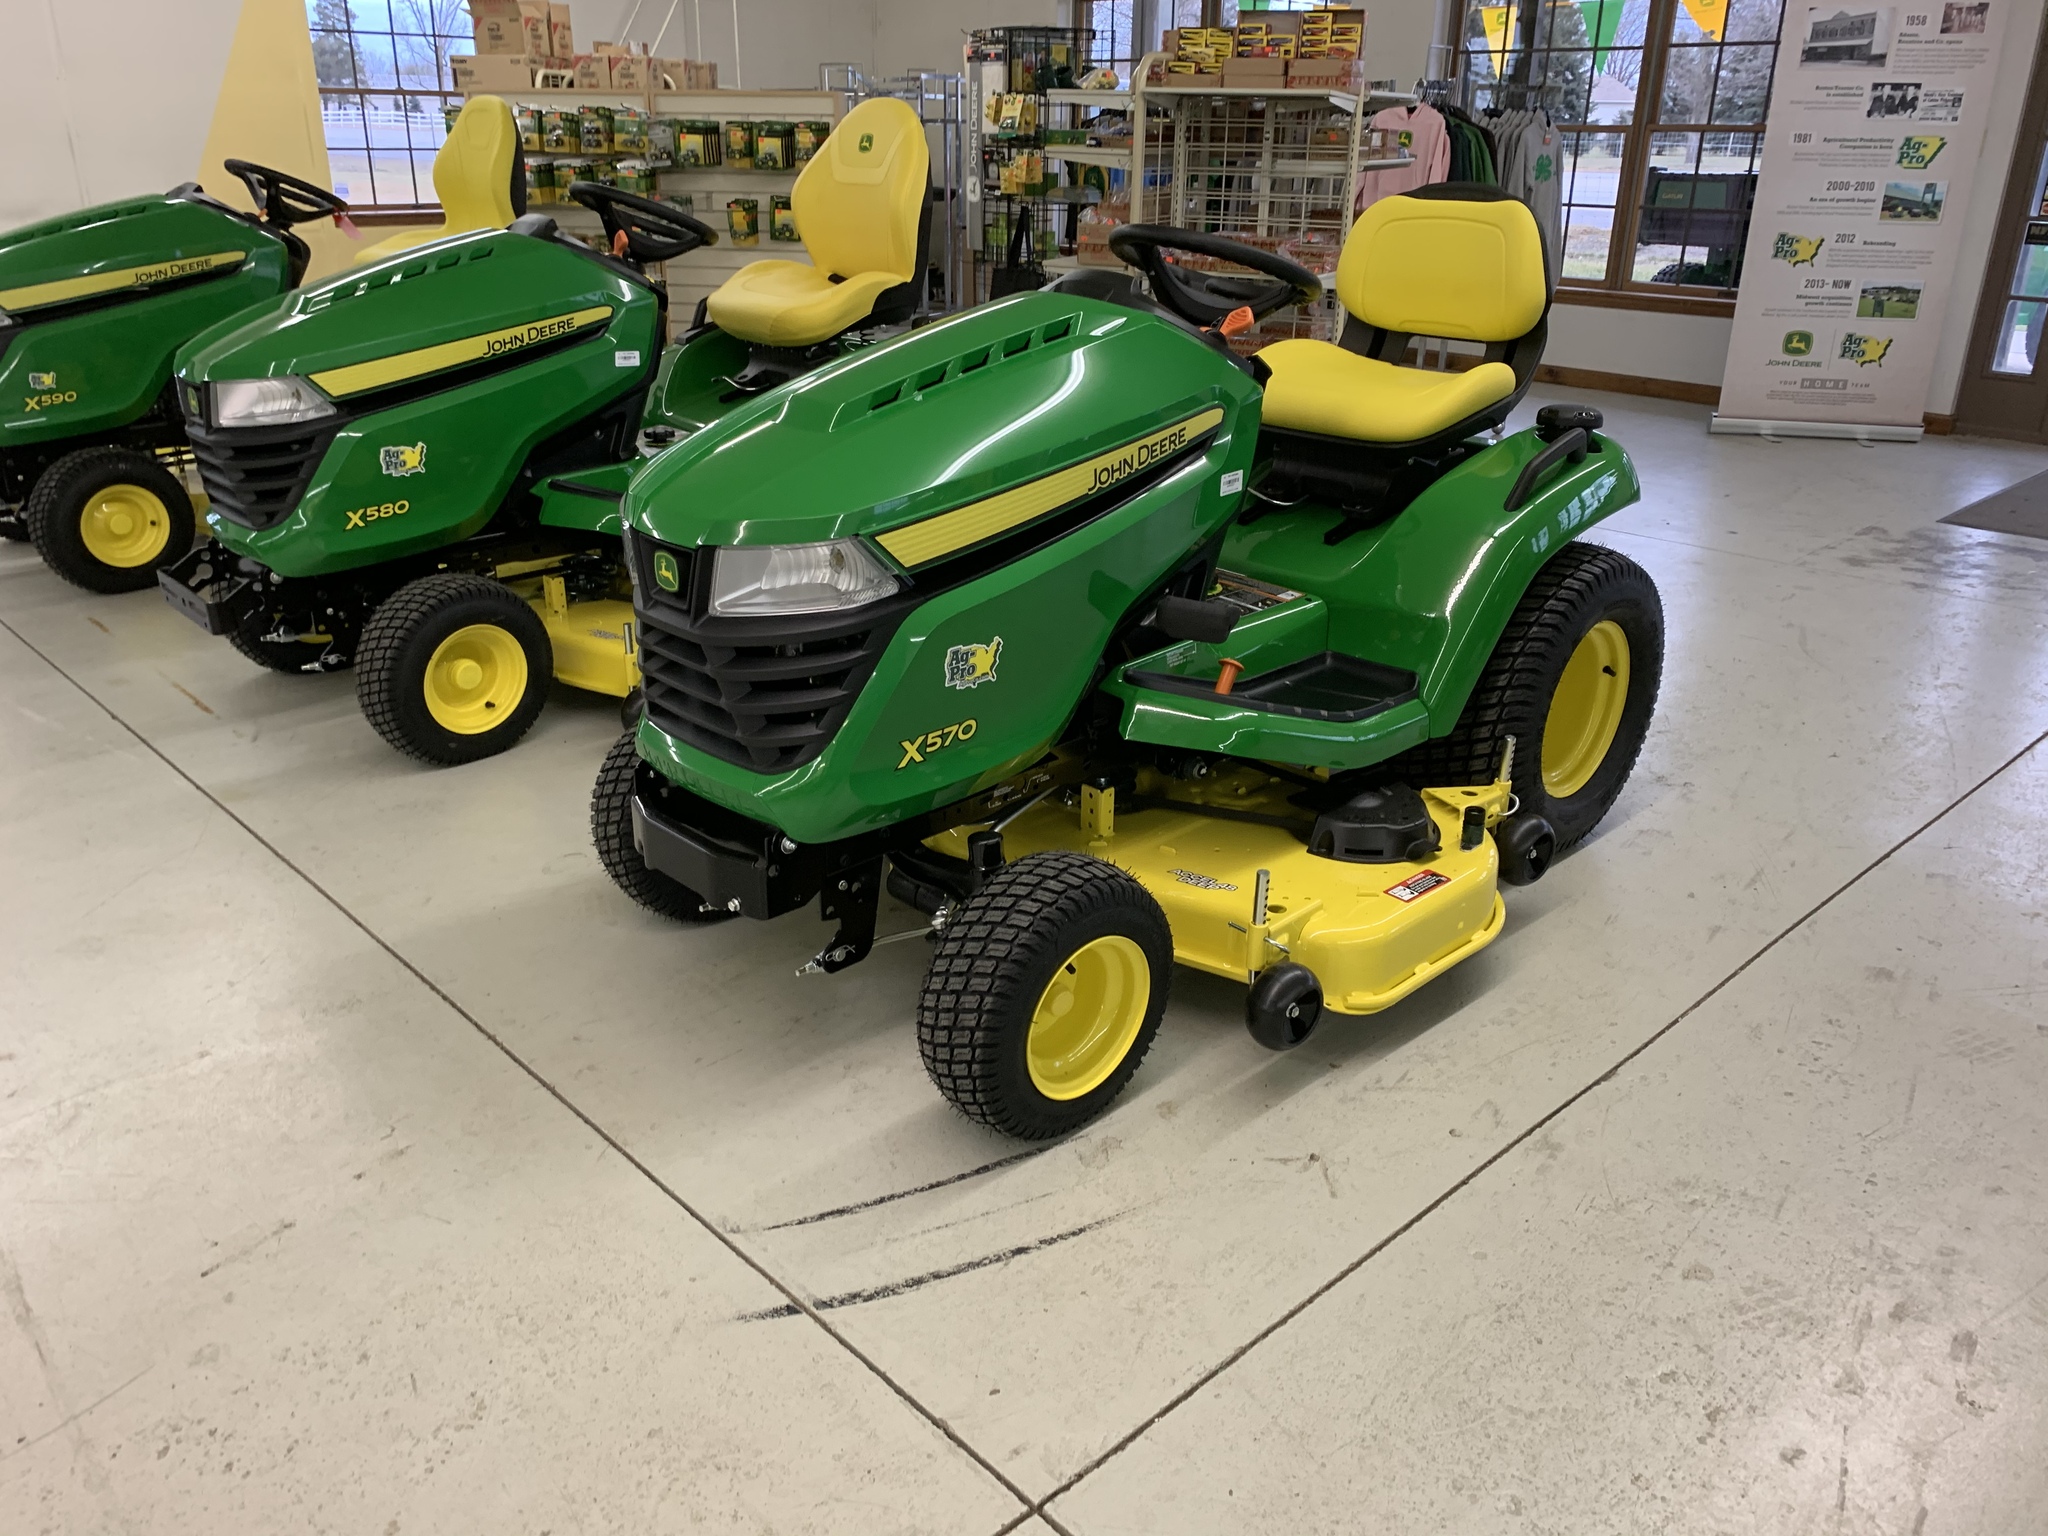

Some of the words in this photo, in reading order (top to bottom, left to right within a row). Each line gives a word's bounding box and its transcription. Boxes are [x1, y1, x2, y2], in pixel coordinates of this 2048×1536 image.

[1906, 15, 1927, 26] 1958
[970, 81, 978, 131] DEERE
[1793, 133, 1812, 144] 1981
[1900, 139, 1927, 153] Ag-
[970, 132, 978, 175] JOHN
[1898, 152, 1925, 164] Pro
[1826, 181, 1875, 192] 2000-2010
[1776, 234, 1799, 248] Ag-
[1835, 233, 1856, 244] 2012
[1773, 246, 1798, 258] Pro
[133, 267, 168, 284] JOHN
[170, 258, 212, 276] DEERE
[1804, 279, 1830, 289] 2013-
[1832, 280, 1852, 290] NOW
[483, 333, 525, 356] JOHN
[527, 317, 576, 342] DEERE
[1842, 334, 1868, 348] Ag-
[1840, 346, 1866, 358] Pro
[1765, 359, 1791, 367] JOHN
[1792, 360, 1822, 368] DEERE
[1803, 380, 1845, 389] HOME
[24, 391, 77, 412] X590
[384, 449, 405, 460] Ag-
[1087, 454, 1135, 493] JOHN
[1137, 427, 1187, 467] DEERE
[385, 460, 407, 471] Pro
[345, 500, 410, 530] X580
[949, 649, 977, 667] Ag-
[949, 664, 976, 682] Pro
[895, 719, 977, 770] X570
